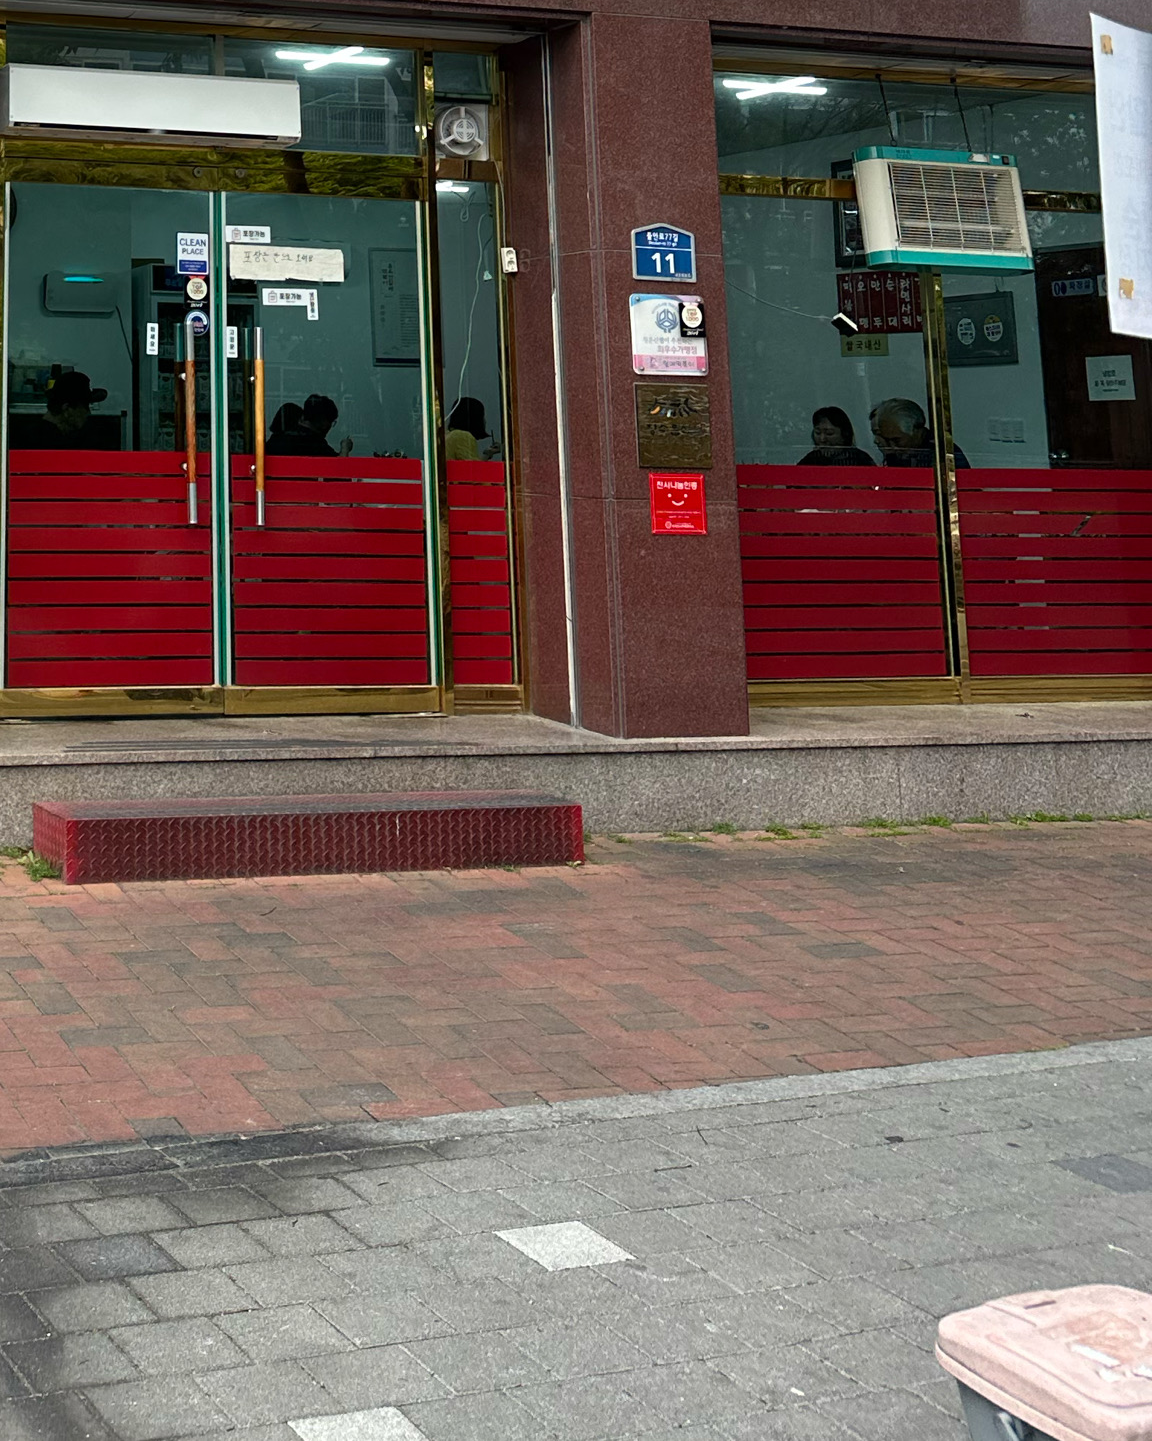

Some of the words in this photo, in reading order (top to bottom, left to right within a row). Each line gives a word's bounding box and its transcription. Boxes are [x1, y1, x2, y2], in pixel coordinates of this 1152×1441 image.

[179, 237, 207, 247] CLEAN
[181, 247, 205, 256] PLACE
[650, 251, 676, 275] 11
